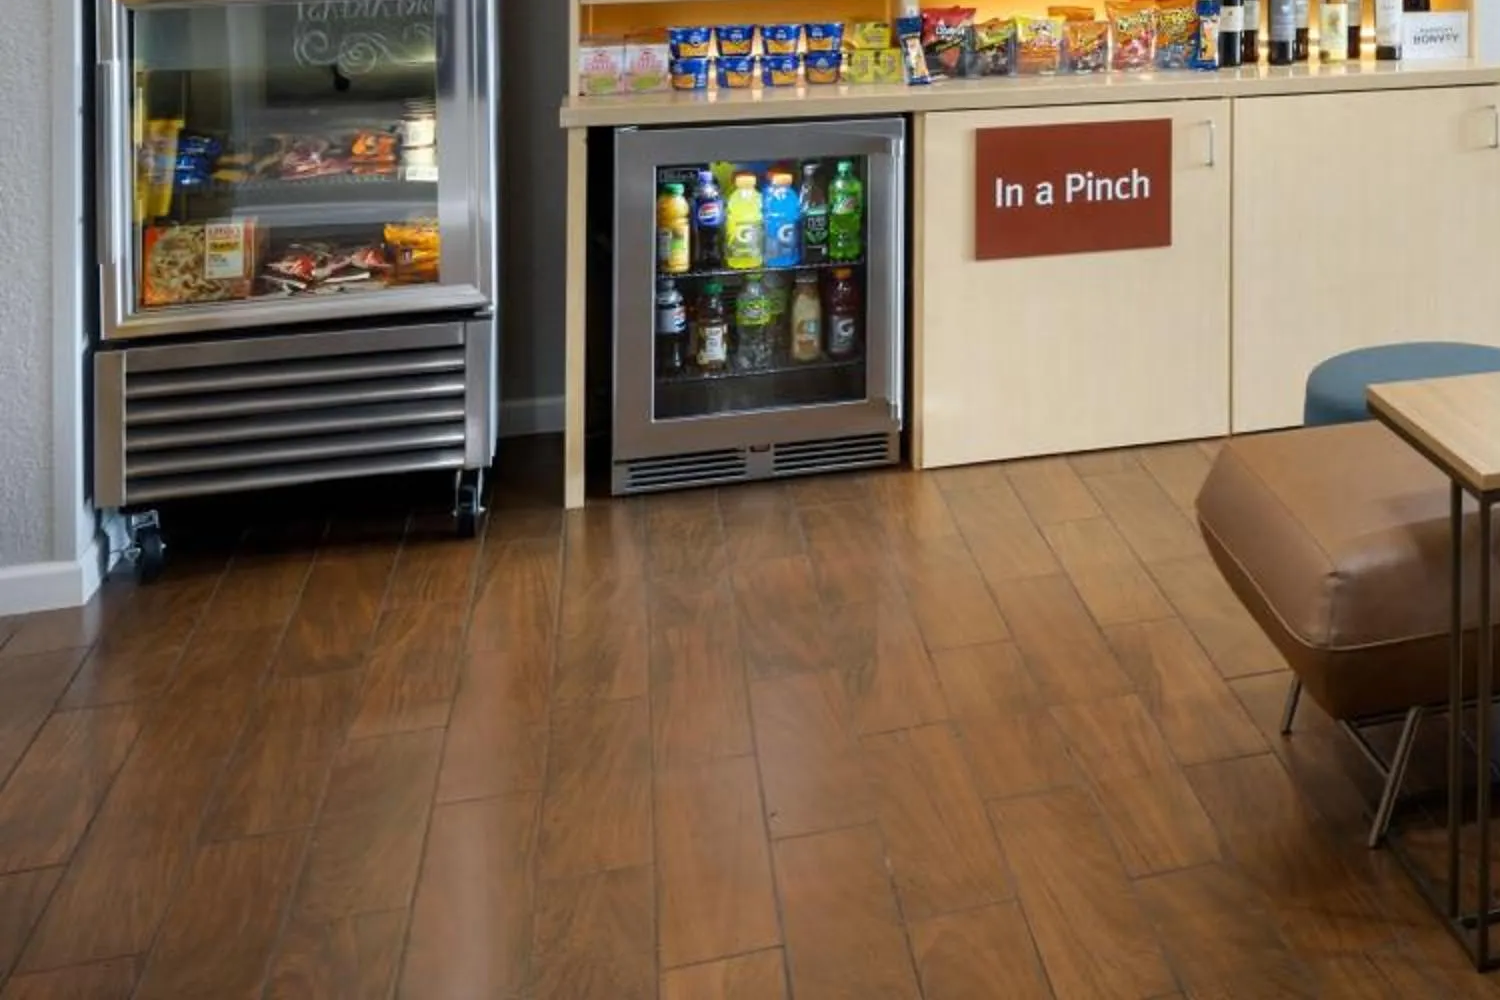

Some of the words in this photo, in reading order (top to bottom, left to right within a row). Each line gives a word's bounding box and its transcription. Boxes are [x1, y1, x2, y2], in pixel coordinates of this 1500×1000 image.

[996, 177, 1024, 208] In
[1035, 181, 1054, 205] a
[1065, 168, 1150, 203] Pinch
